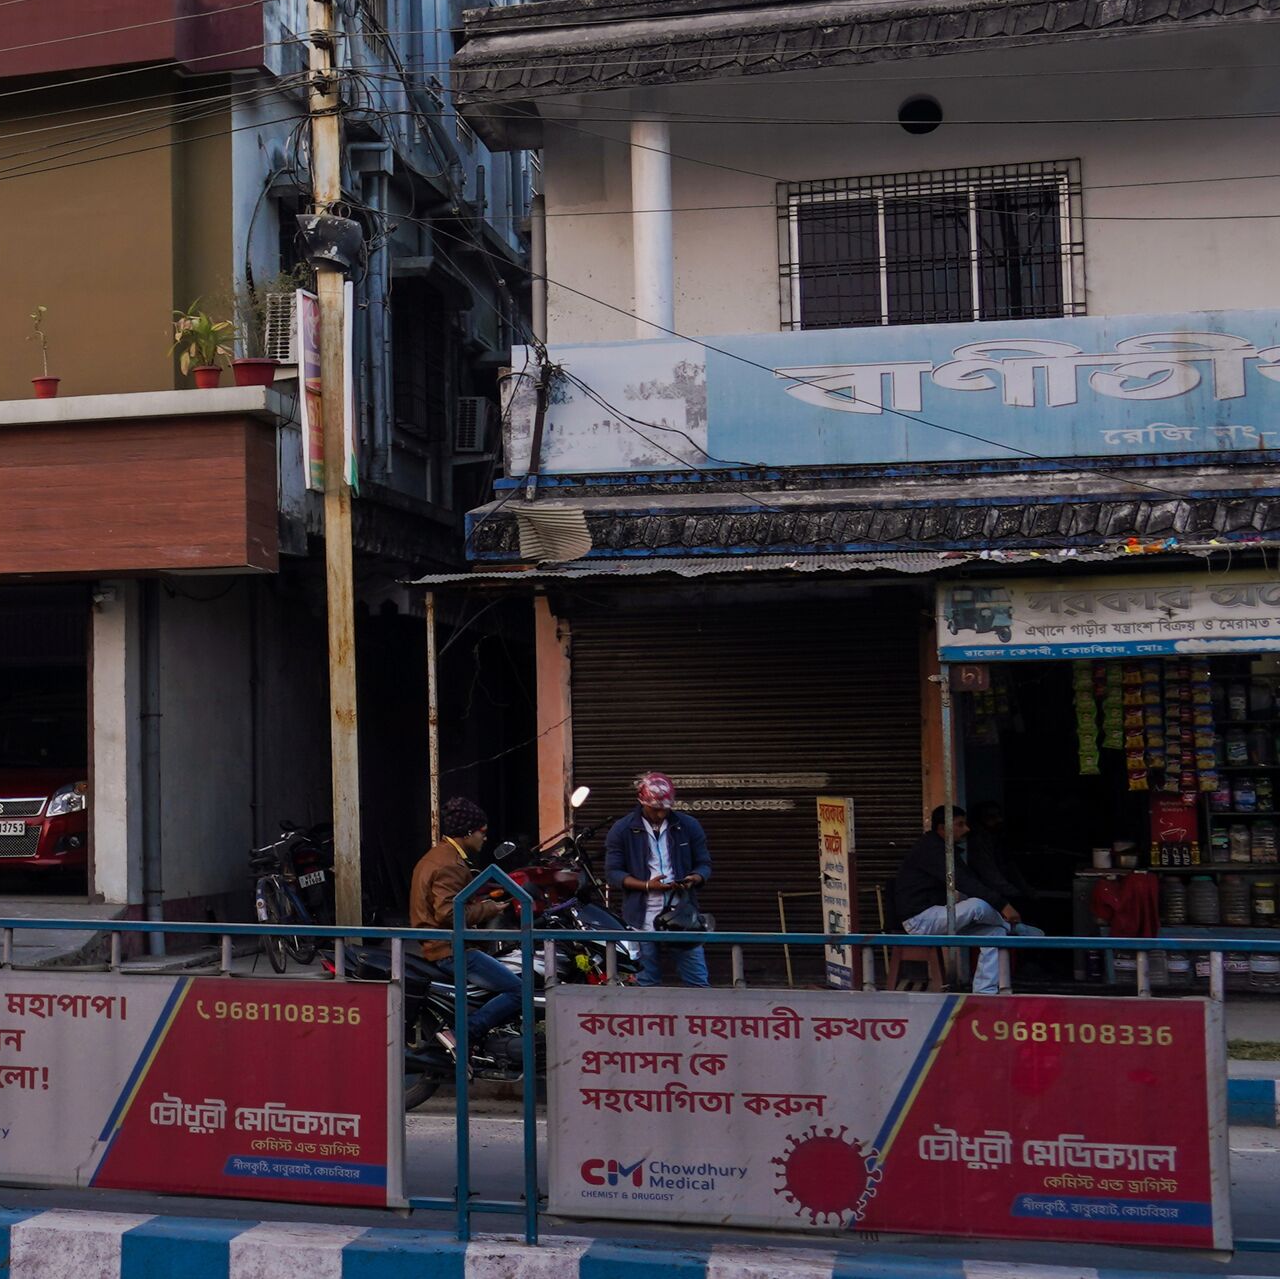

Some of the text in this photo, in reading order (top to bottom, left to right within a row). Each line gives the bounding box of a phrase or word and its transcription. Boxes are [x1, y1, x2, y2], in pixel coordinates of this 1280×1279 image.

[774, 331, 1280, 414] বাণীতী
[1024, 625, 1065, 637] এখানে
[1202, 619, 1214, 630] ও
[1219, 618, 1271, 631] মেরামত
[215, 1001, 361, 1026] 9681108336
[578, 1006, 909, 1042] করোনা মহামারী রুখতে
[993, 1020, 1174, 1047] 9681108336
[580, 1049, 727, 1076] প্রশাসন কে
[580, 1080, 827, 1118] সহযোগিতা করুন
[150, 1092, 361, 1138] চৌধুরী মেডিক্যাল
[251, 1138, 292, 1153] কেমিস্ট
[319, 1141, 361, 1157] ড্রাগিস্ট
[919, 1123, 1177, 1171] চৌধুরী মেডিক্যাল
[649, 1161, 748, 1179] Chowdhury
[581, 1190, 618, 1199] CHEMIST
[631, 1192, 674, 1201] DRUGGIST
[649, 1176, 715, 1191] Medical
[1043, 1173, 1093, 1190] কেমিস্ট
[1127, 1177, 1178, 1194] ড্রাগিস্ট
[1023, 1197, 1069, 1216] নীলকুঠি,
[1122, 1204, 1179, 1219] কোচবিহার
